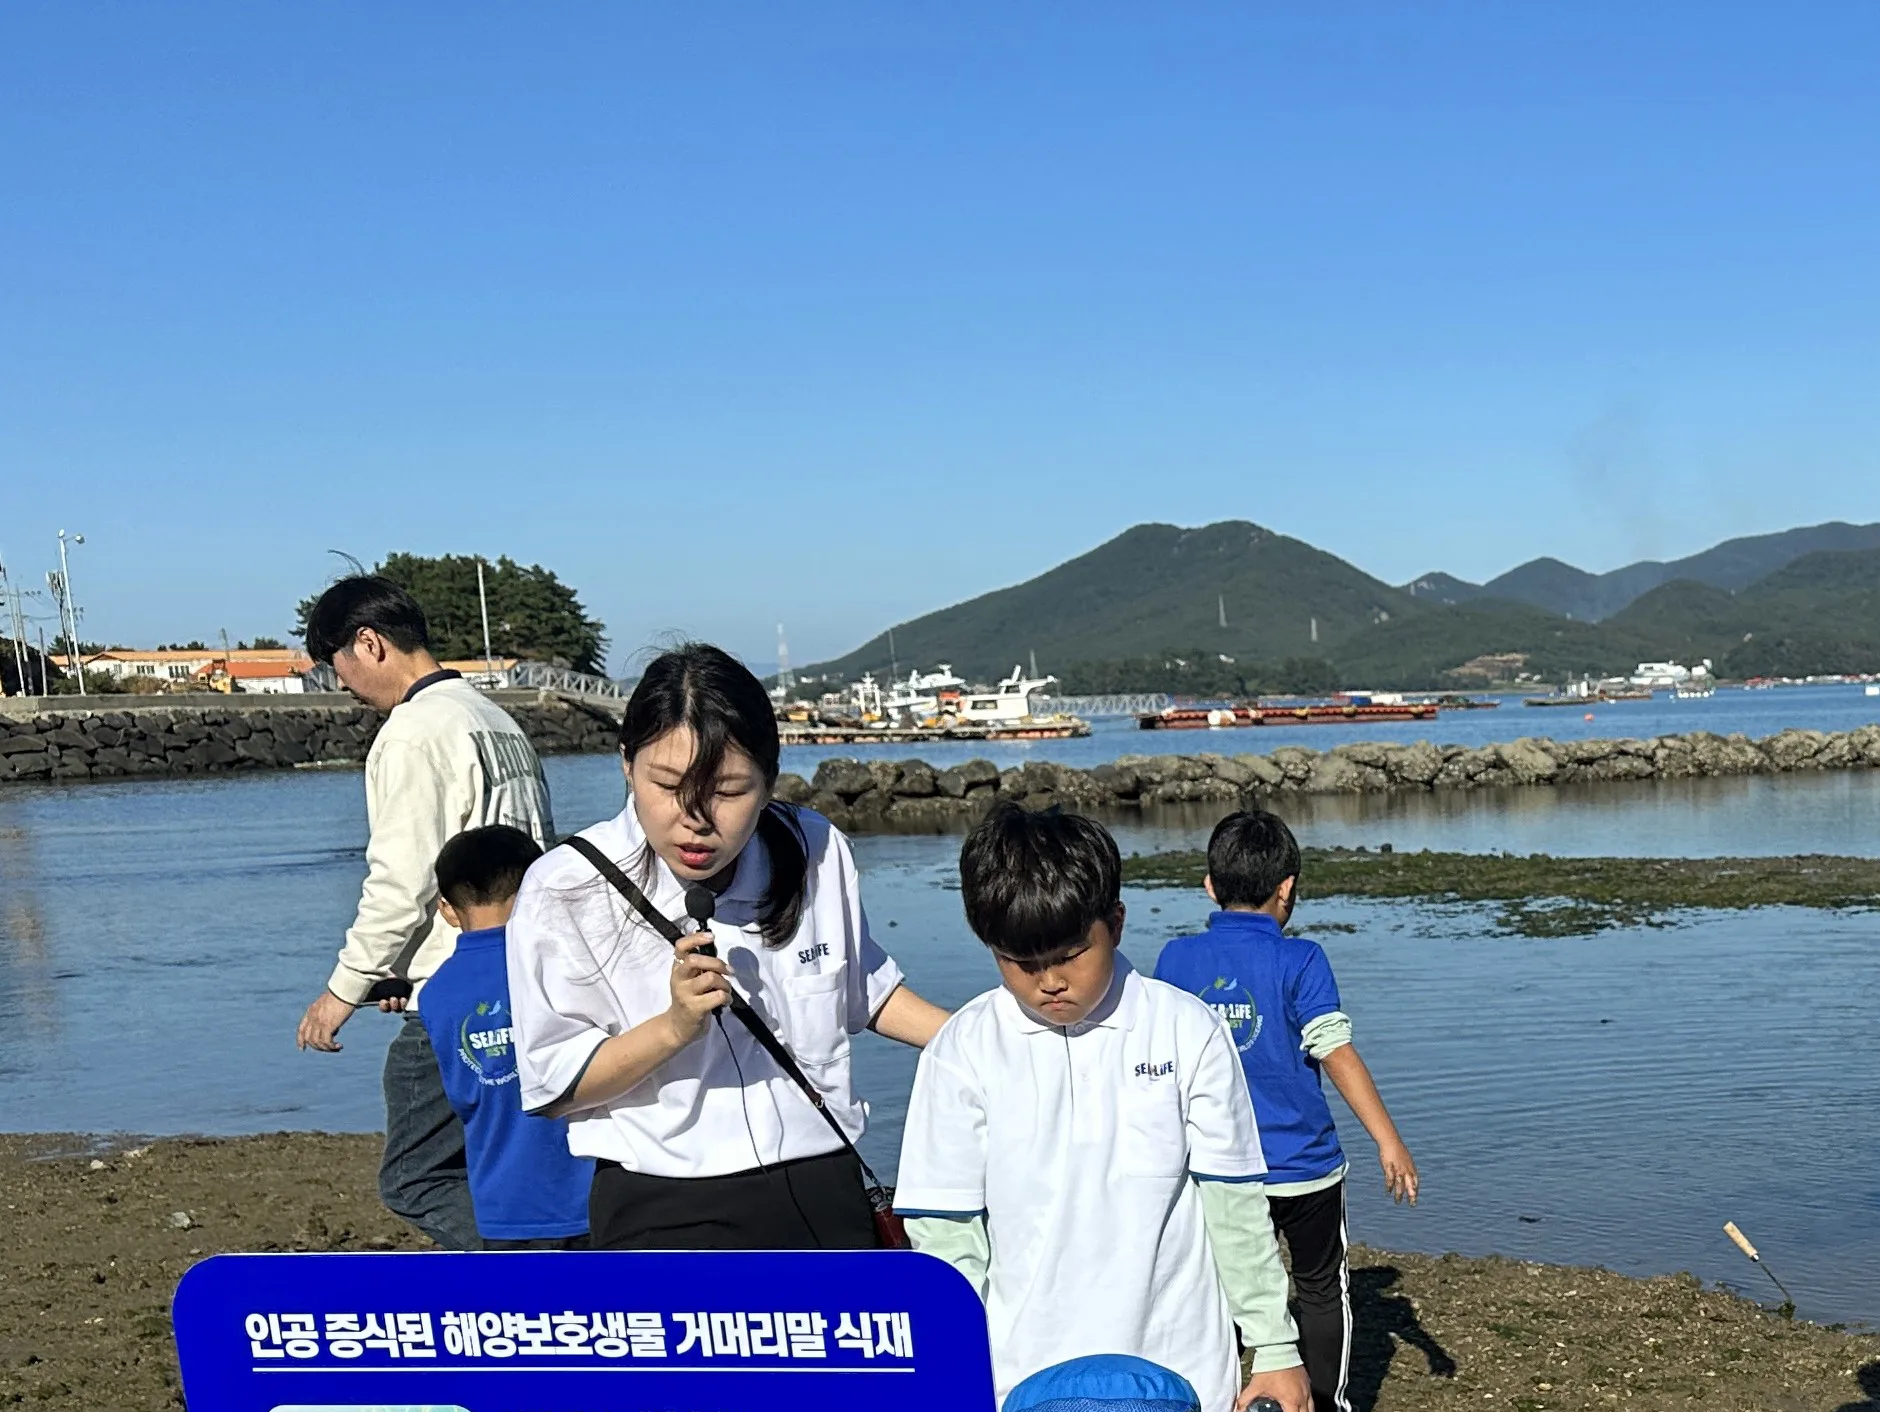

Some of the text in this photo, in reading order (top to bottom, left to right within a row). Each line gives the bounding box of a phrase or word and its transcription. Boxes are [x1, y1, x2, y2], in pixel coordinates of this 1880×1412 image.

[244, 1310, 914, 1359] 인공 증식된 해양보호생물 거머리말 식재
